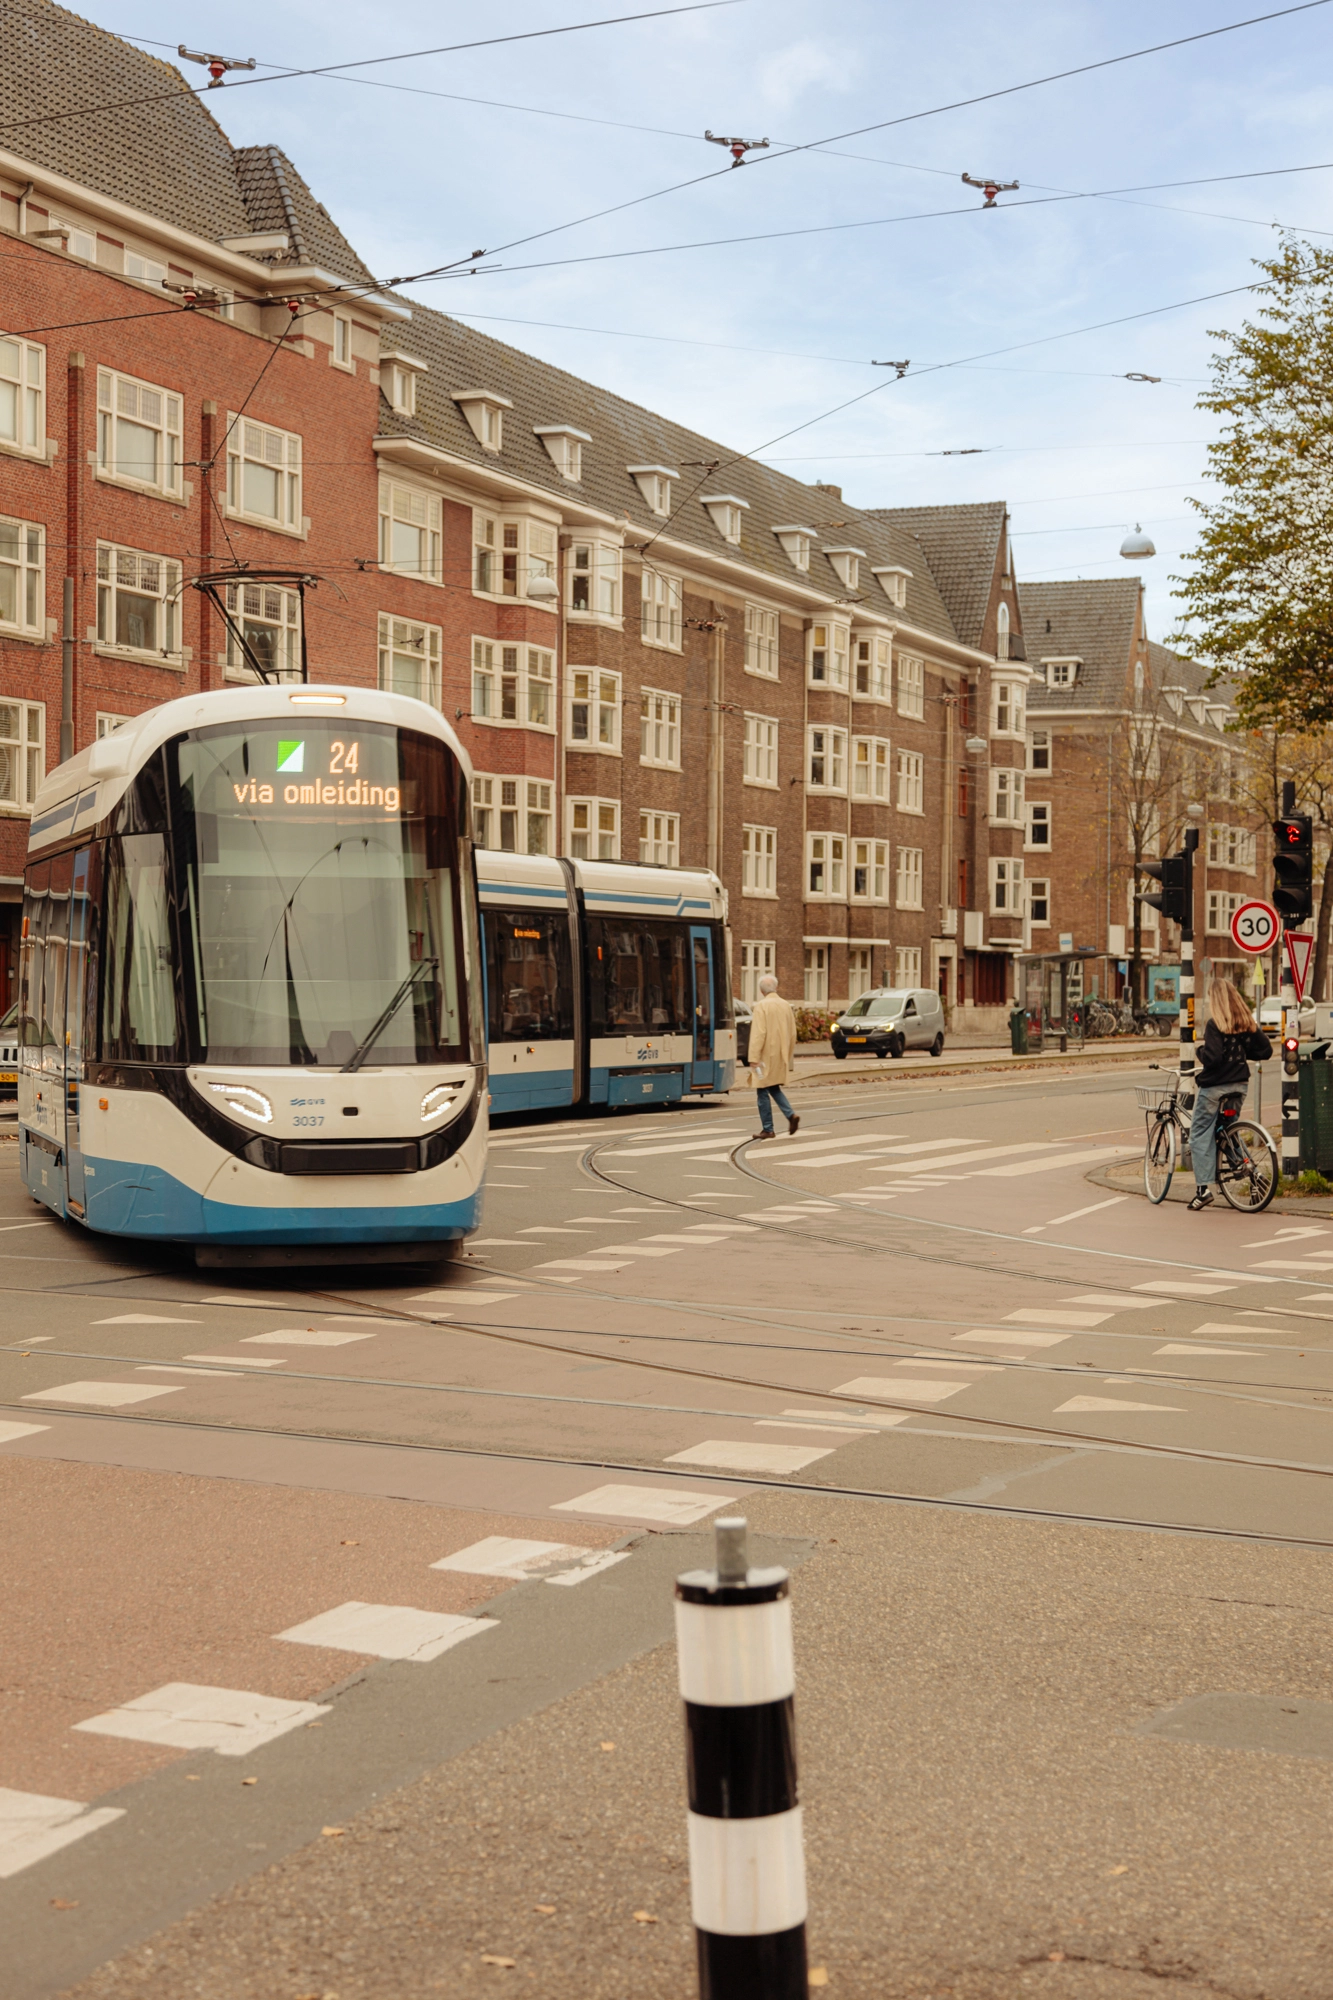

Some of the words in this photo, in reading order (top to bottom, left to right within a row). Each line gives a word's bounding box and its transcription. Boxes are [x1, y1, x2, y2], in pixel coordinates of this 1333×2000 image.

[329, 741, 358, 774] 24
[233, 778, 273, 803] via
[284, 778, 400, 812] omleiding
[1241, 917, 1270, 937] 30
[293, 1116, 325, 1126] 3037
